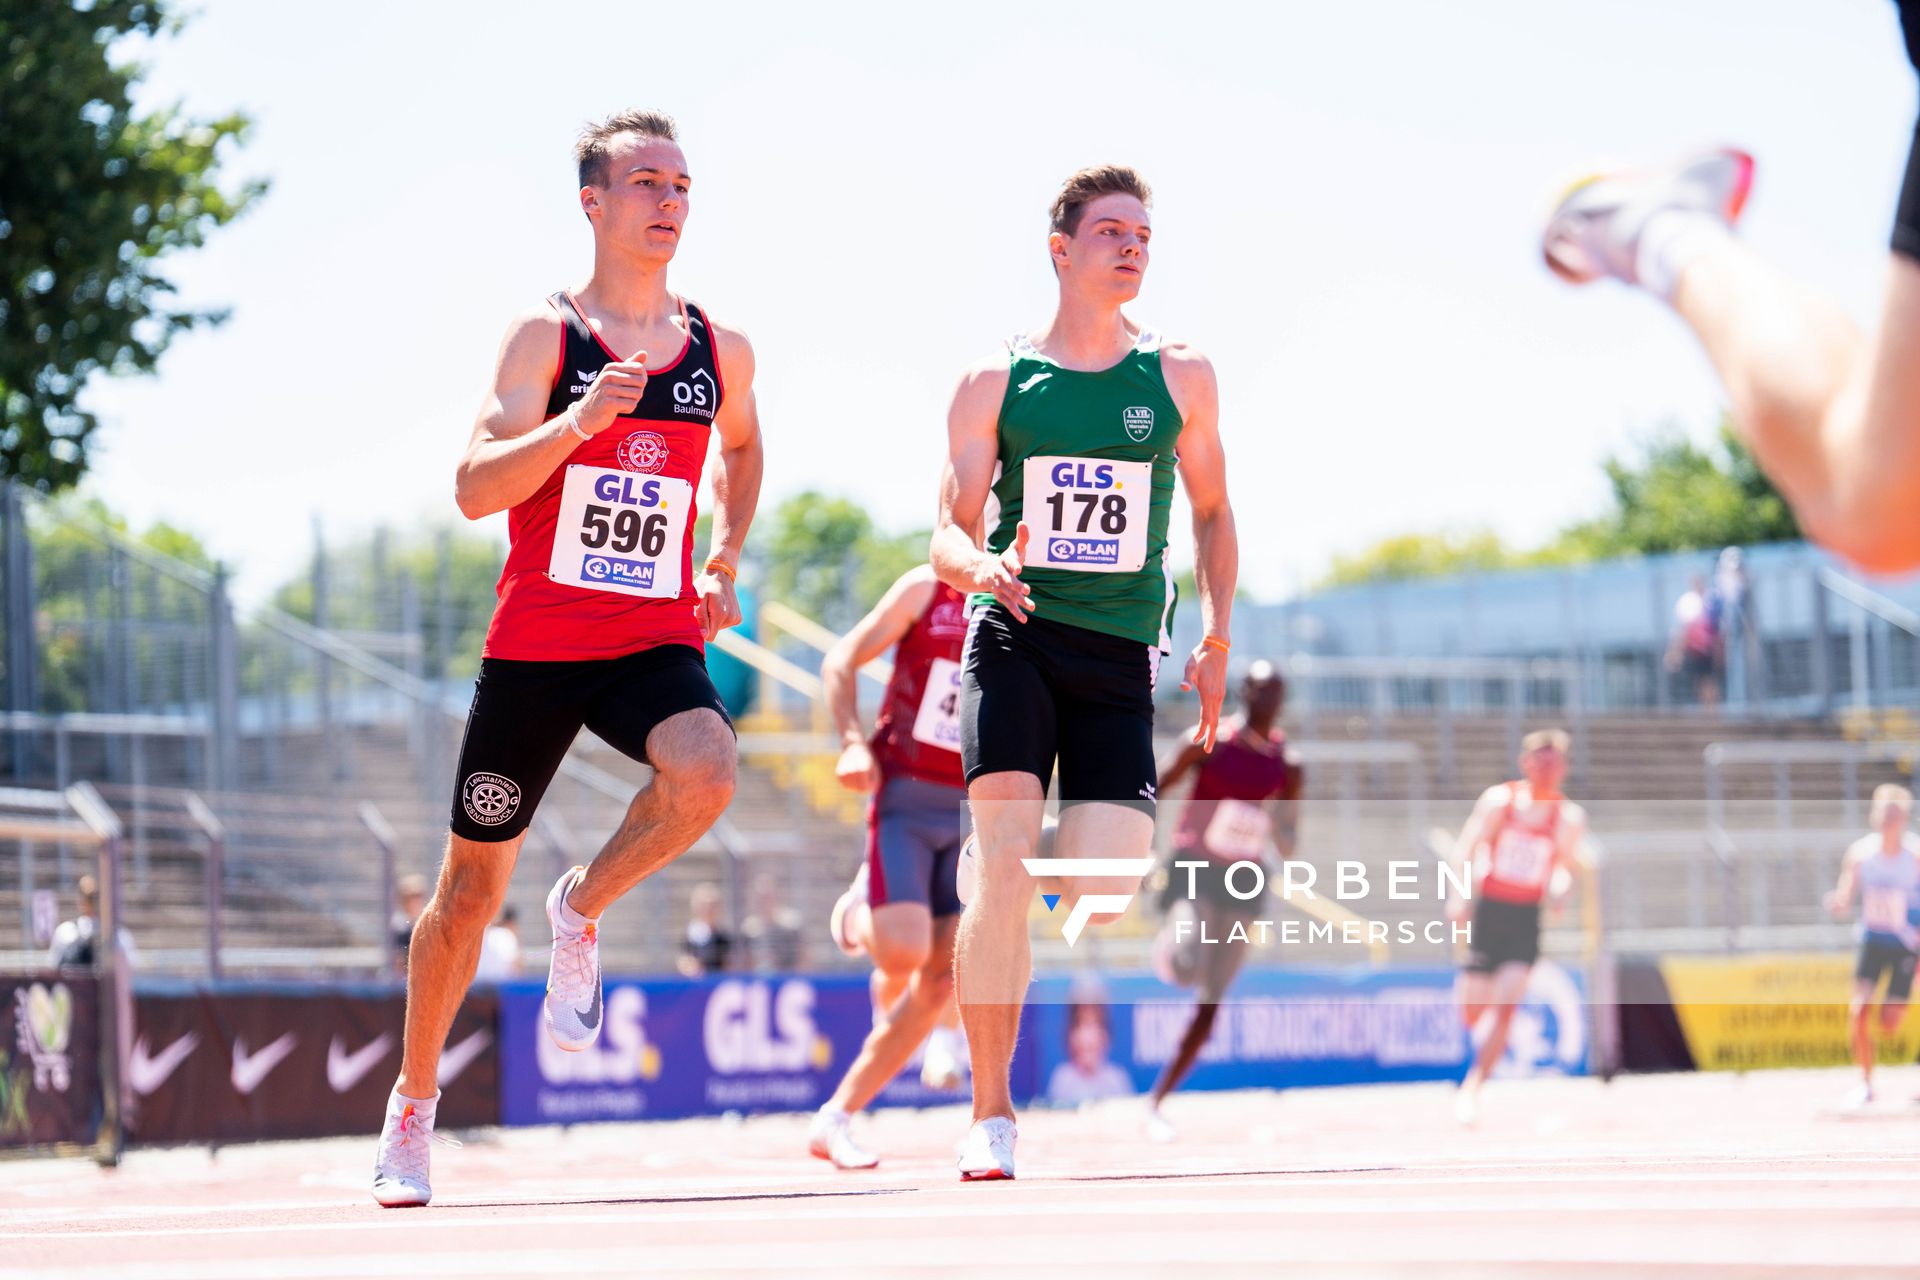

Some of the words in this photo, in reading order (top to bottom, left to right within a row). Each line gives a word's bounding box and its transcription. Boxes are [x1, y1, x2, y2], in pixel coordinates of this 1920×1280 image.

[673, 382, 707, 405] OS
[1046, 492, 1127, 534] 178
[580, 504, 668, 557] 596
[1077, 543, 1117, 556] PLAN
[612, 562, 653, 580] PLAN
